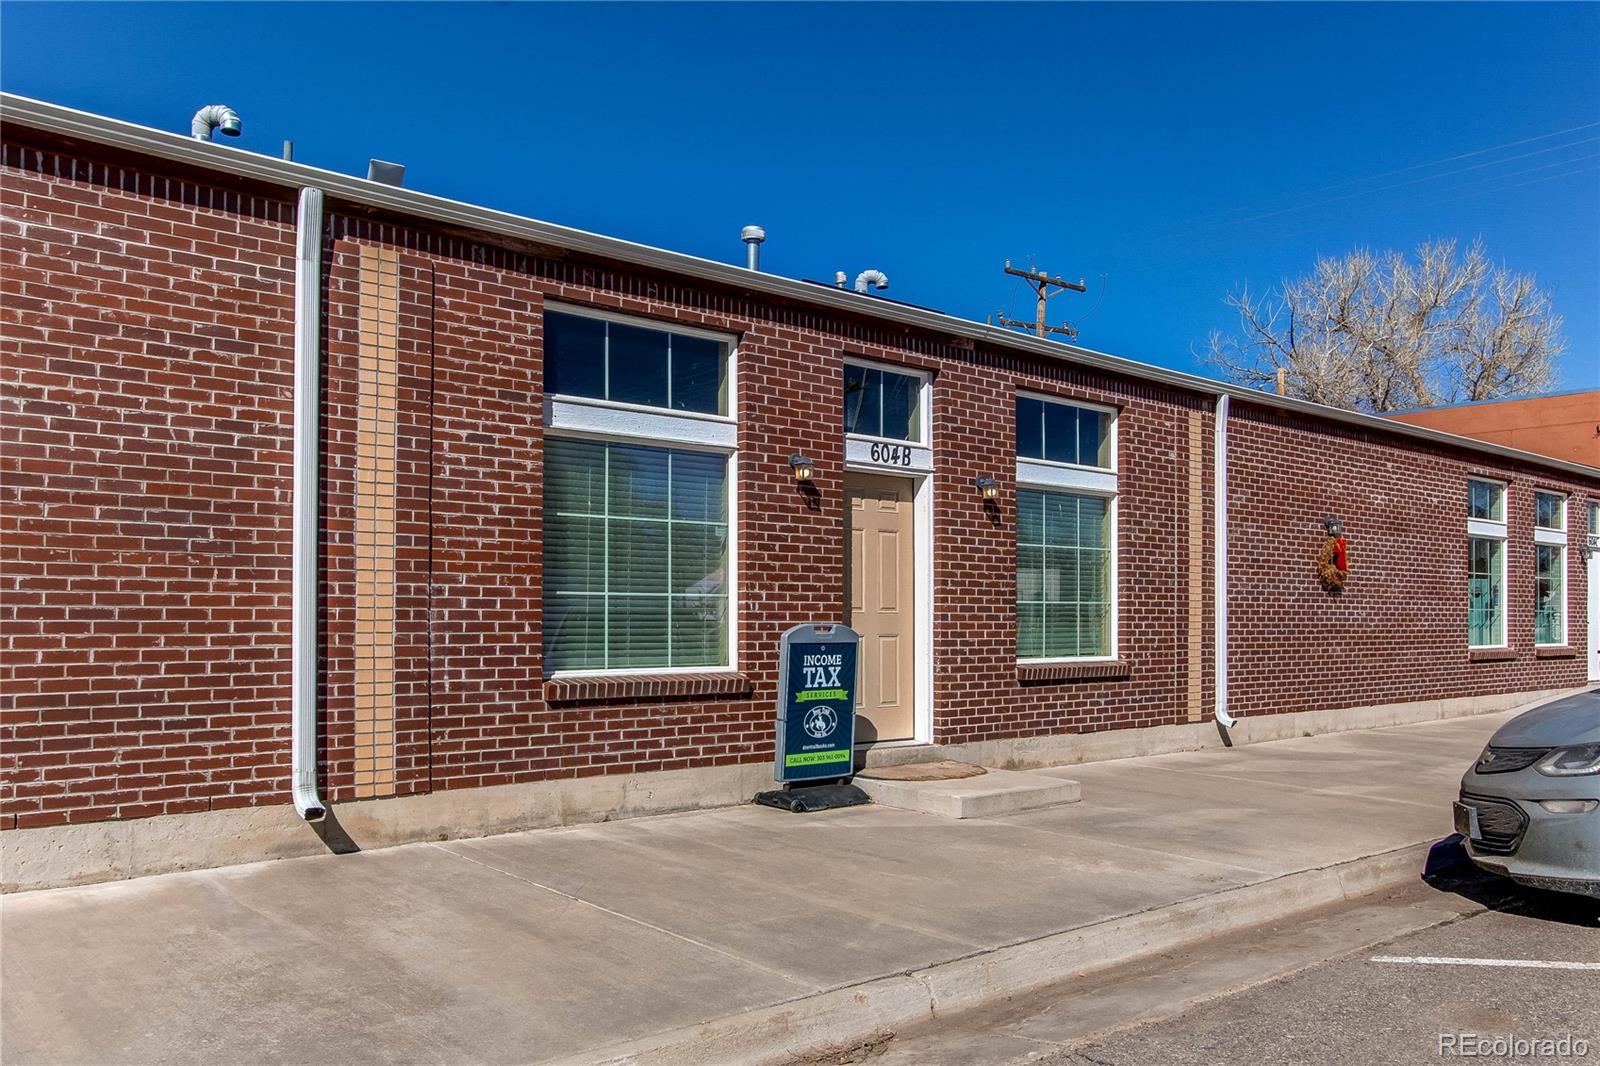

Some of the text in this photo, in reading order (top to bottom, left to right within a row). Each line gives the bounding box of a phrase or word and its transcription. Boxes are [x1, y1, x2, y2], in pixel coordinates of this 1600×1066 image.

[870, 442, 912, 466] 604B
[803, 654, 842, 666] INCOME
[803, 666, 842, 688] TAX
[806, 691, 837, 699] SERVICES
[789, 757, 803, 765] CALL
